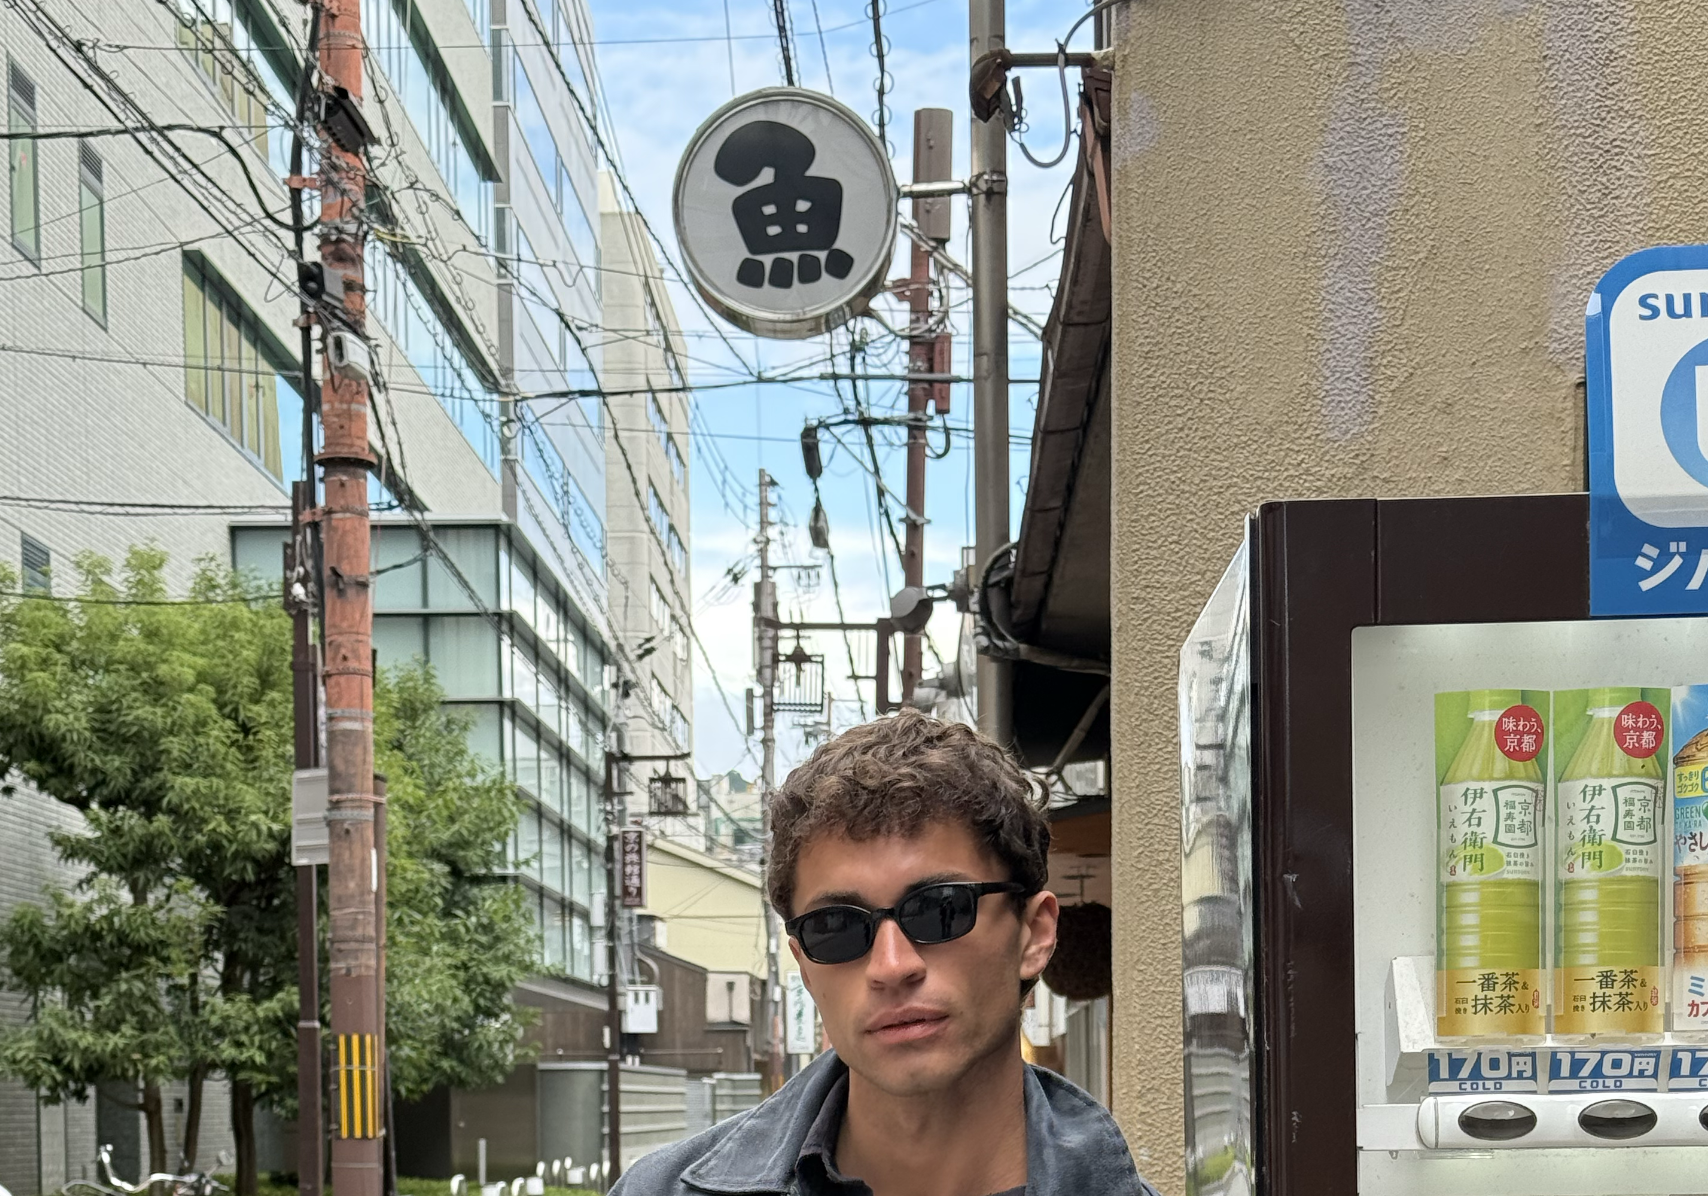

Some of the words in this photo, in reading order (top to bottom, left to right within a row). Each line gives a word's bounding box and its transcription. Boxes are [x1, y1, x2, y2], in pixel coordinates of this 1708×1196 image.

[713, 120, 854, 289] 魚
[1638, 292, 1708, 321] SU
[1503, 734, 1537, 752] 京都
[1622, 731, 1656, 749] 京都
[1677, 770, 1699, 782] すっきり
[1677, 782, 1699, 793] ゴクゴク
[1517, 798, 1533, 836] 京都
[1636, 795, 1652, 833] 京都
[1675, 805, 1701, 819] GREEN
[1448, 804, 1458, 859] いえもん
[1461, 787, 1488, 872] 伊右衛門
[1566, 801, 1576, 857] いえもん
[1578, 783, 1606, 870] 伊右衛門
[1688, 975, 1705, 997] ミ
[1471, 994, 1530, 1015] 抹茶入り
[1589, 991, 1648, 1012] 抹茶入り
[1433, 1051, 1533, 1079] 170円
[1556, 1052, 1656, 1078] 170円
[1458, 1081, 1503, 1091] COLD
[1579, 1079, 1623, 1089] COLD
